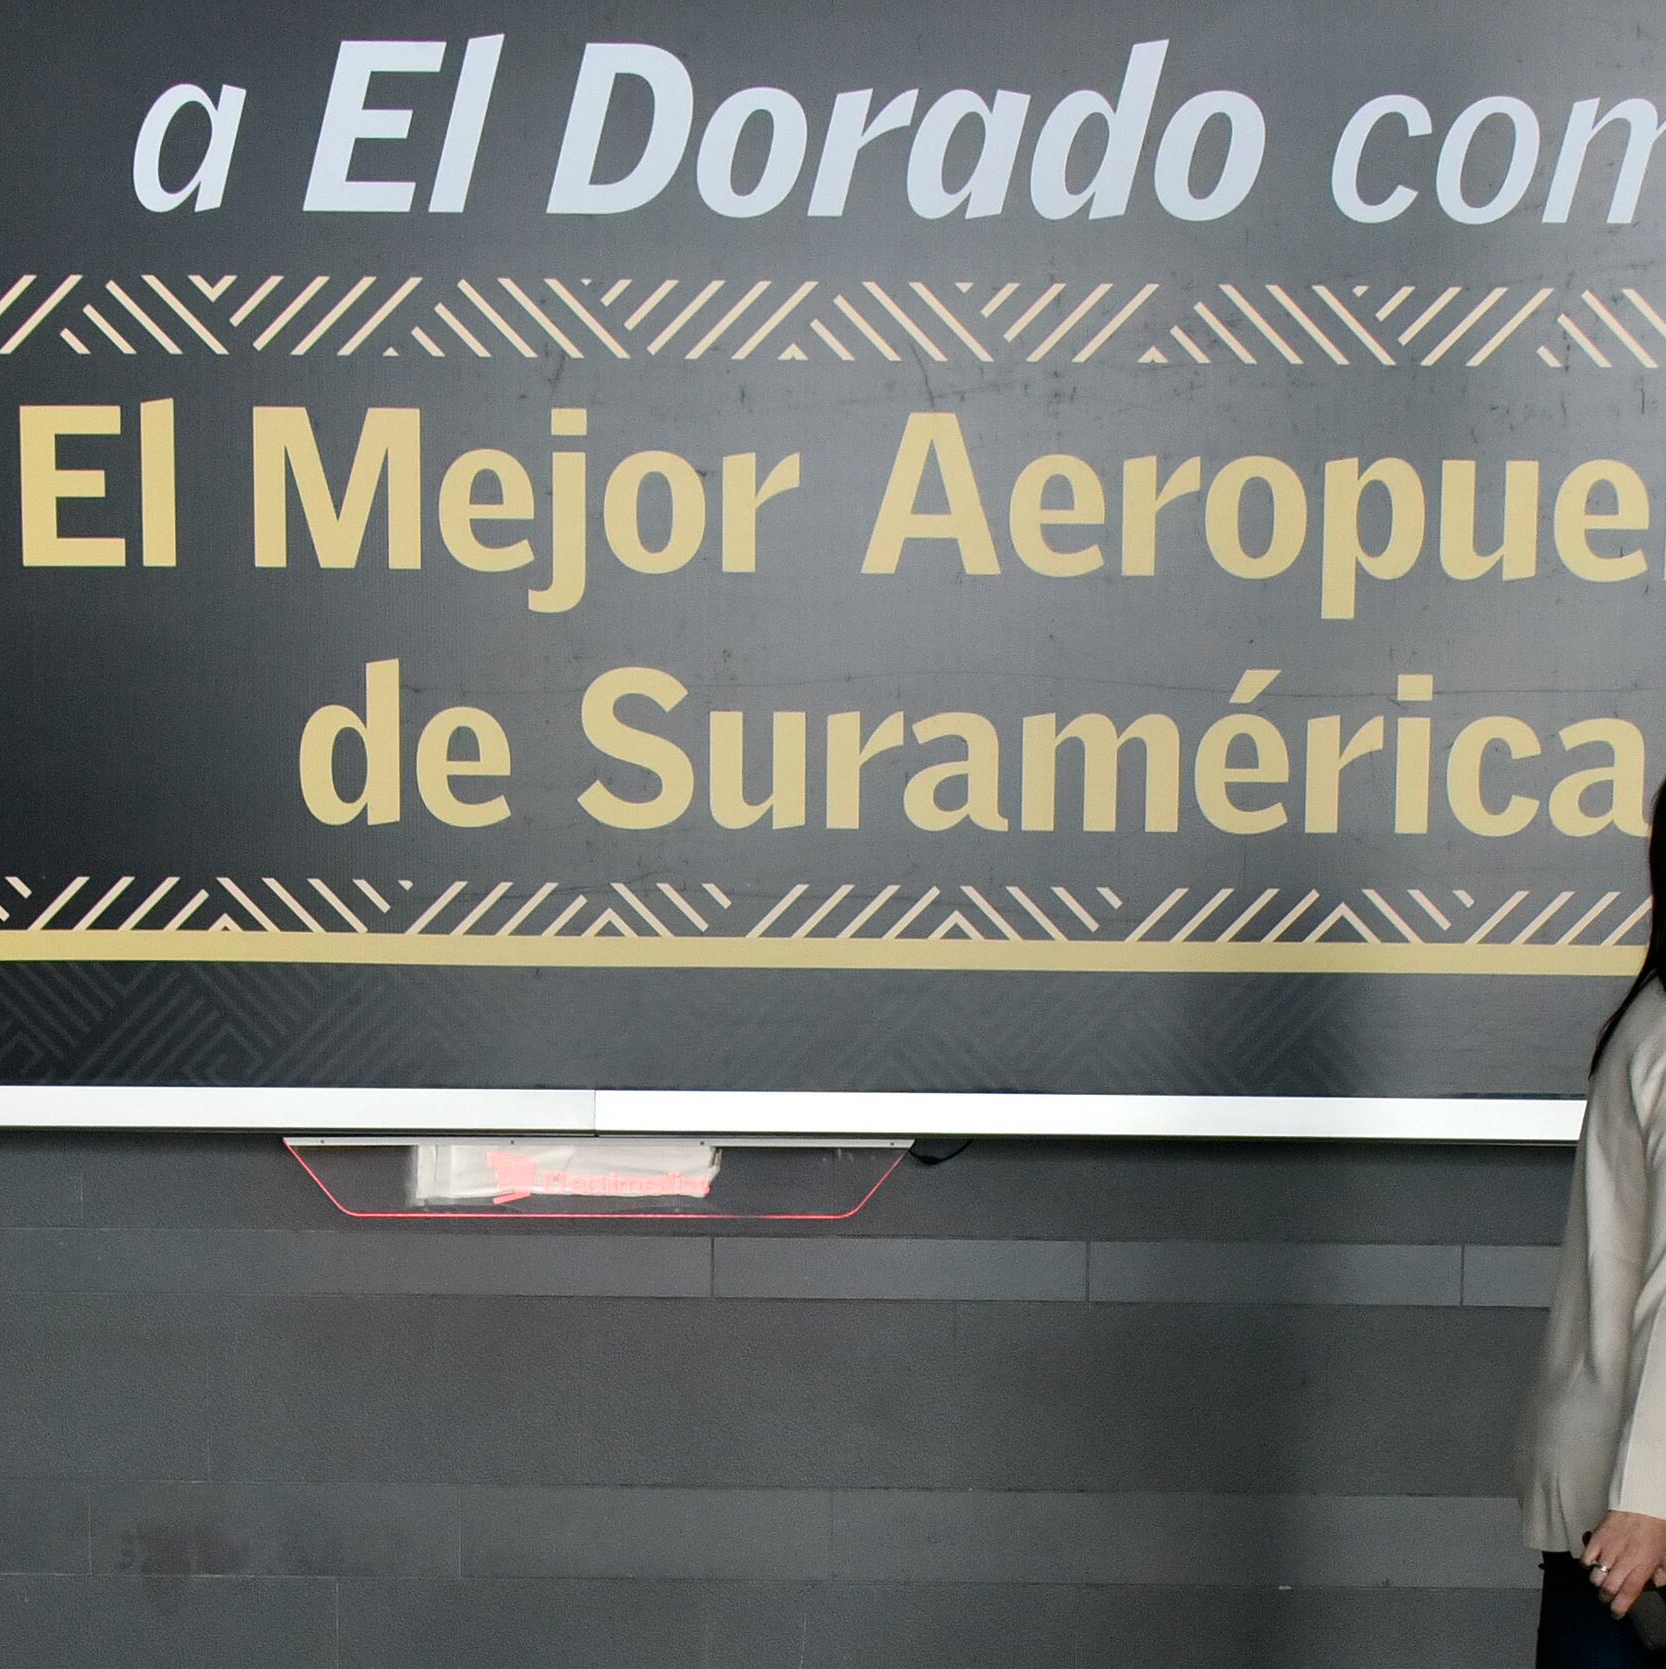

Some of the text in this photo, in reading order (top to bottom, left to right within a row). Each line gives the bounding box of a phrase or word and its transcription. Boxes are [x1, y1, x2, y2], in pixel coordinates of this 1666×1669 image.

[132, 83, 246, 213] a
[302, 33, 505, 214] El
[546, 38, 1266, 222] Dorado
[19, 397, 176, 567] El
[252, 405, 800, 613] Mejor
[299, 657, 1650, 838] de Suramérica
